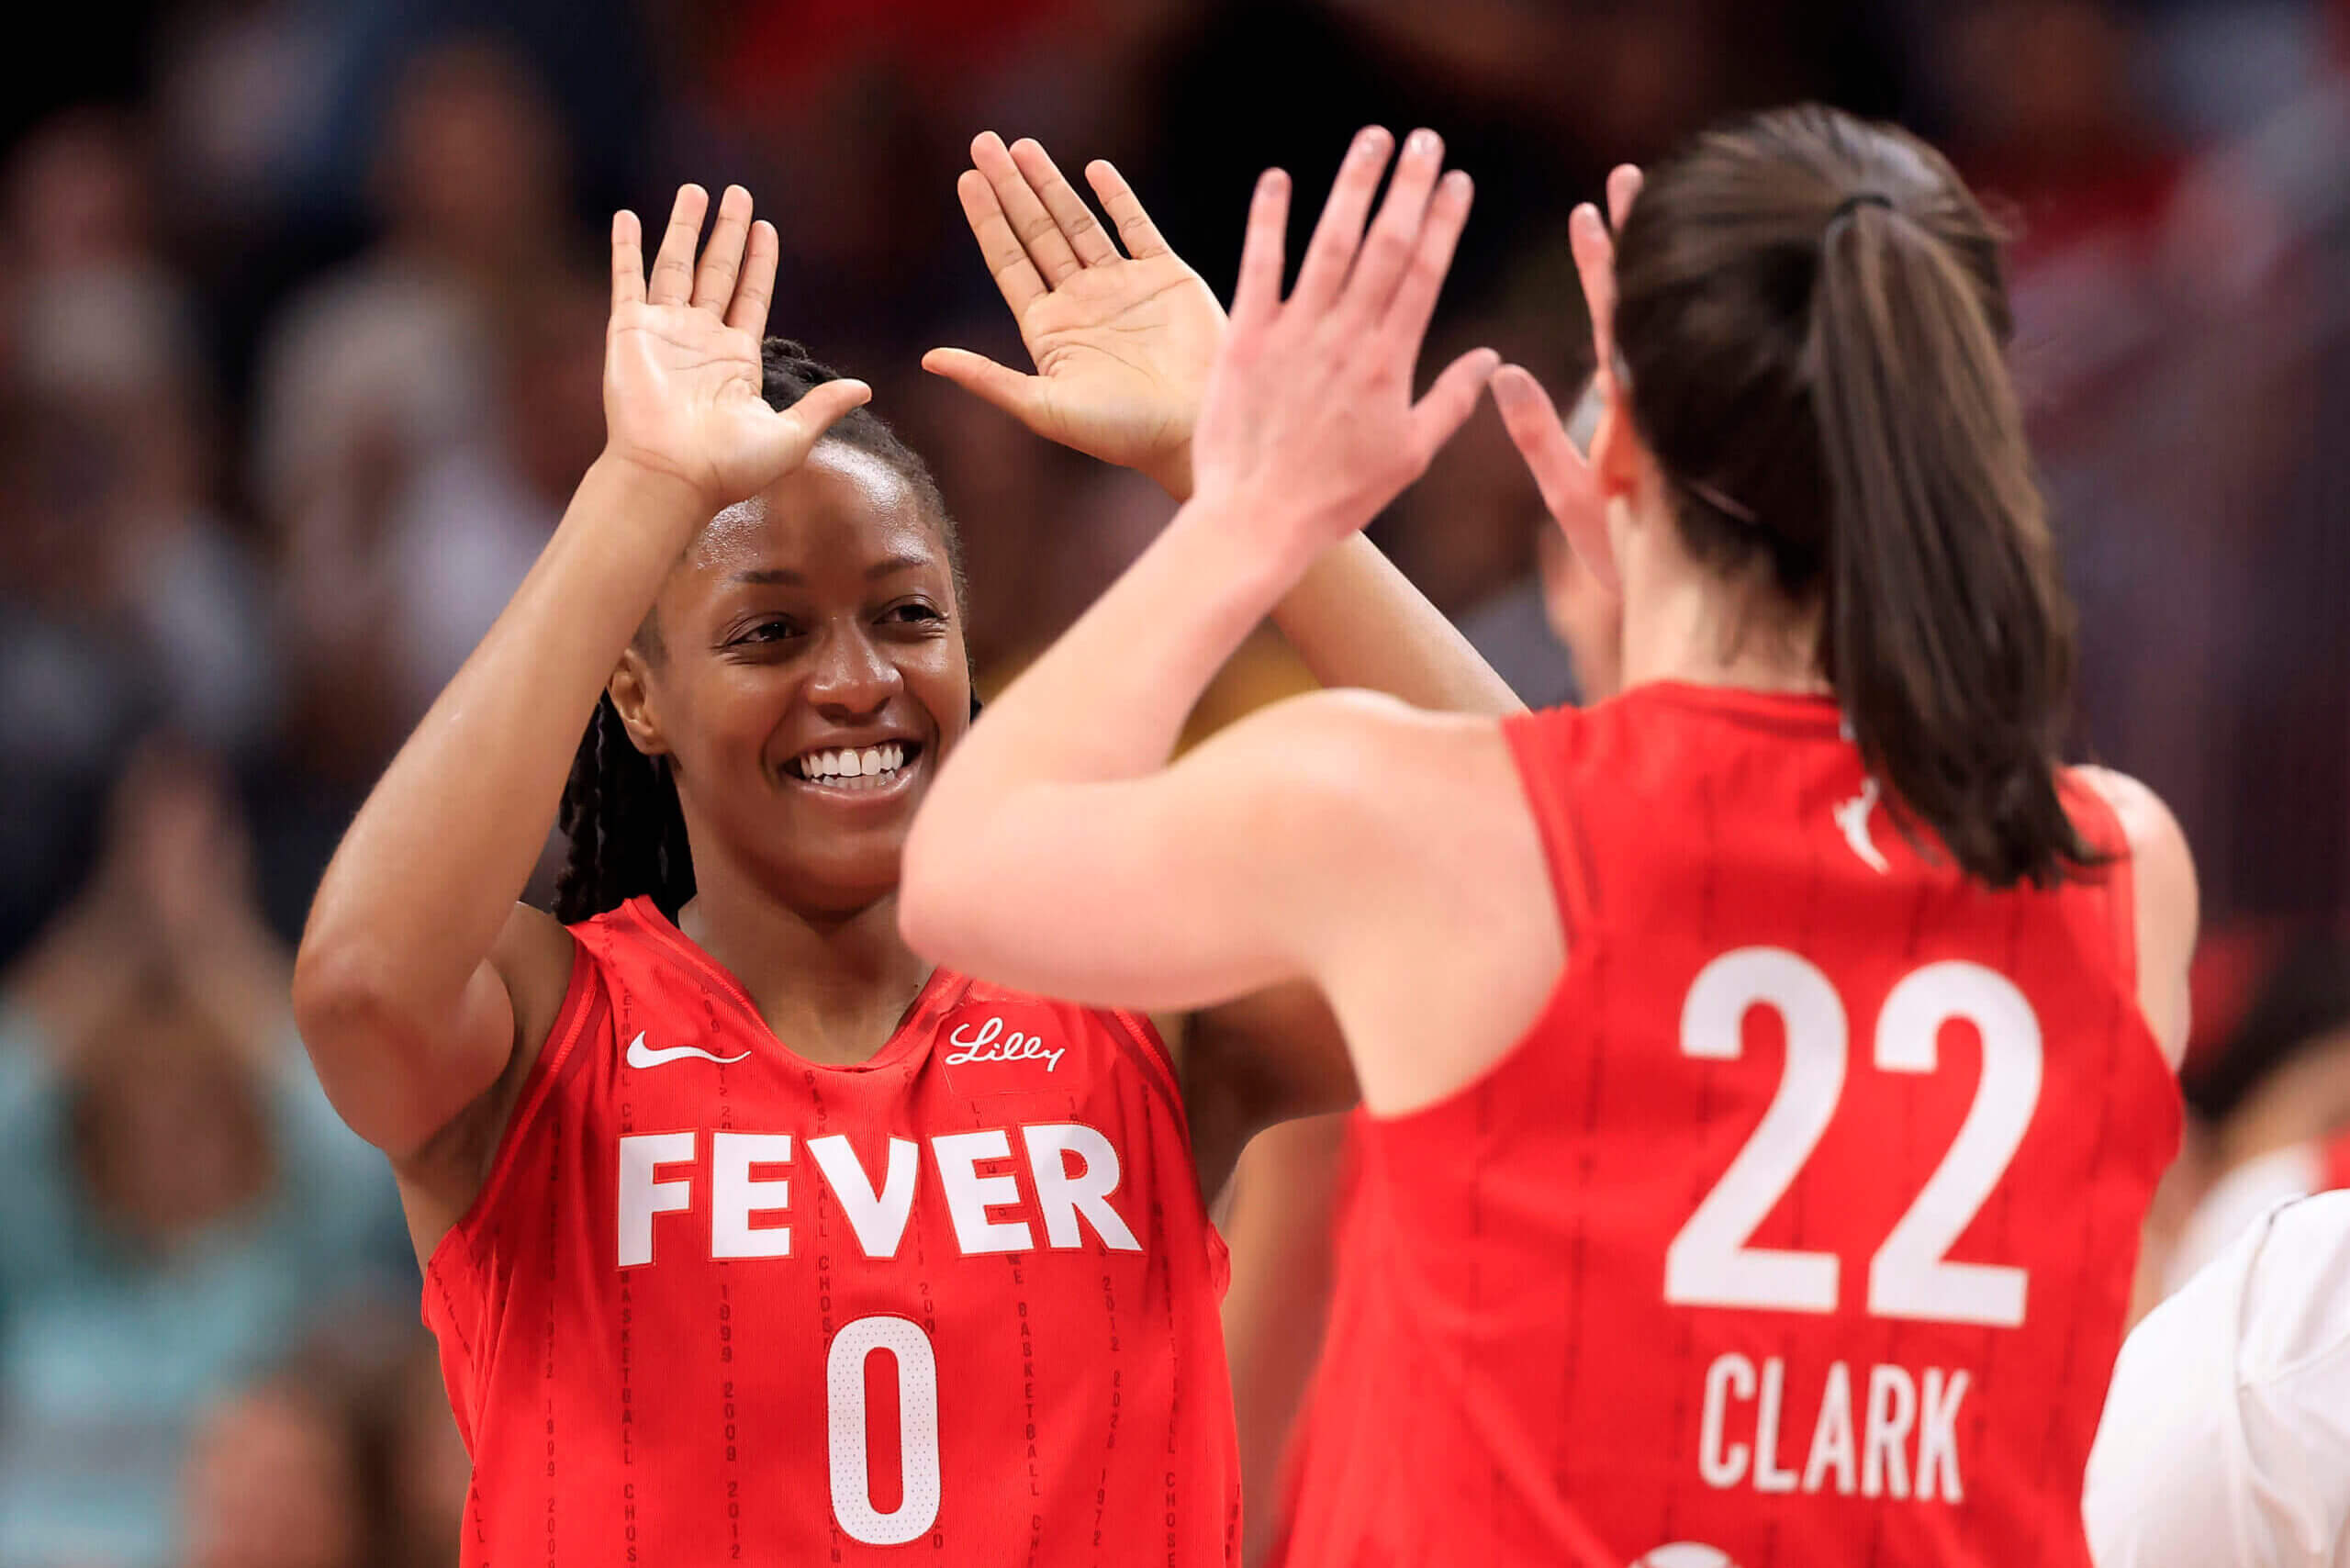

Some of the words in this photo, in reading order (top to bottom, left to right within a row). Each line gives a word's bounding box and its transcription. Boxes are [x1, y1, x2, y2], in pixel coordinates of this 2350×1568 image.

[945, 1016, 1066, 1072] Lilly
[618, 1124, 1143, 1267] FEVER
[1664, 947, 2043, 1327] 22
[826, 1315, 940, 1545] 0
[1700, 1353, 1969, 1502] CLARK
[624, 1483, 641, 1568] CHOS
[727, 1480, 742, 1561] 2012
